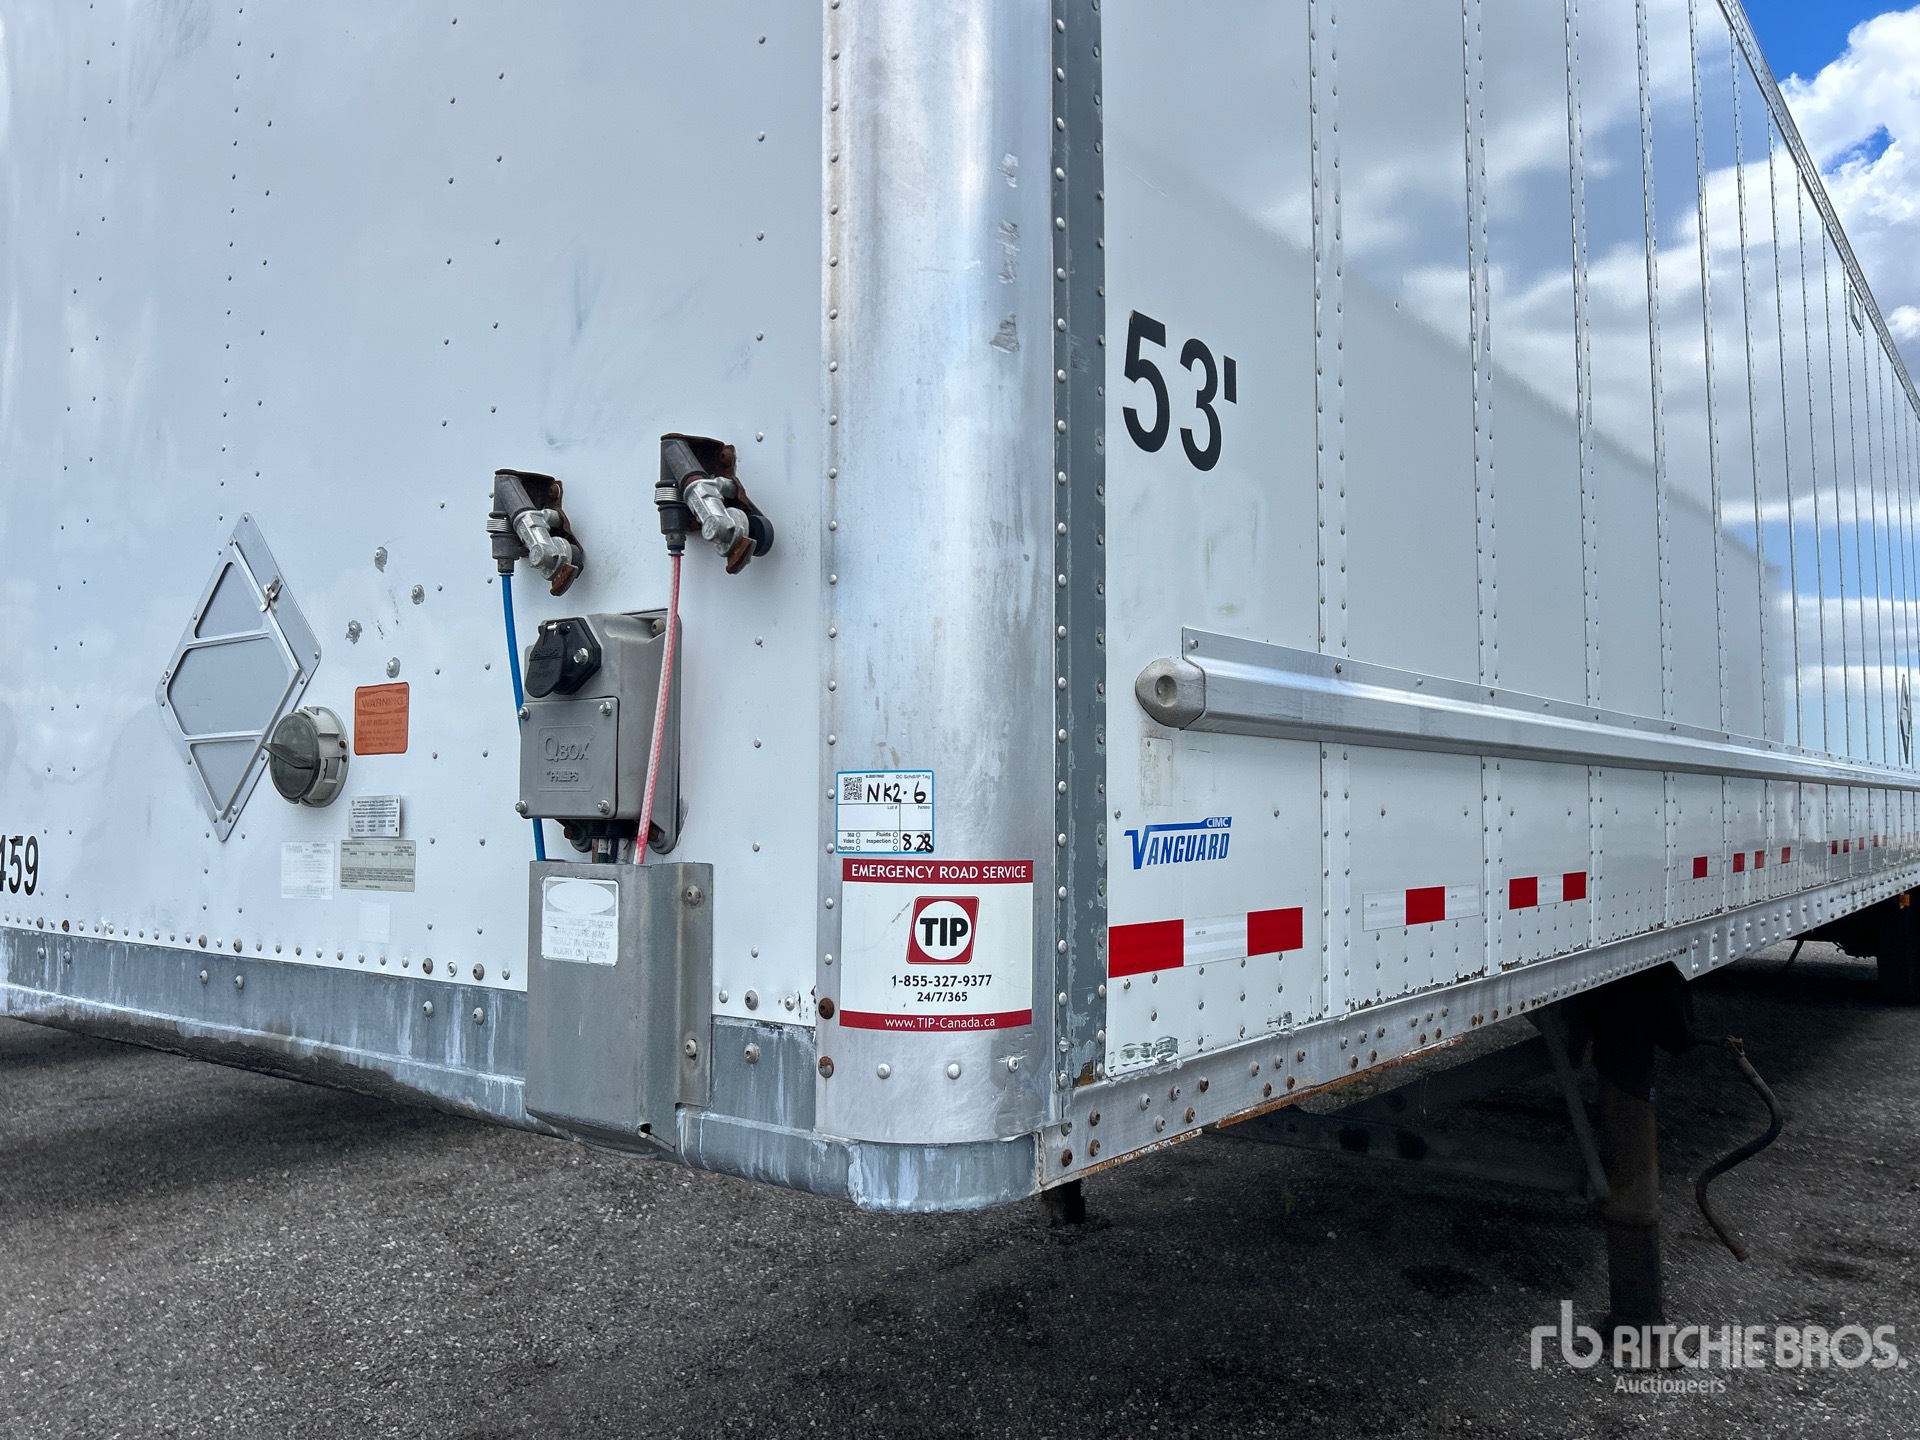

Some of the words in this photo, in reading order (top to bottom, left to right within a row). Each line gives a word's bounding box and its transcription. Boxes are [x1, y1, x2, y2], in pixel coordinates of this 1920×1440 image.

[1122, 309, 1237, 472] 53'
[1206, 817, 1229, 828] CIMC
[1124, 825, 1230, 870] VANGUARD
[851, 863, 935, 879] EMERGENCY
[939, 865, 979, 879] ROAD
[982, 865, 1027, 879] SERVICE
[919, 917, 969, 946] TIP
[891, 974, 992, 987] 1-855-327-9377
[917, 991, 968, 1002] 24/7/365
[885, 1017, 996, 1029] www.TIP-Canada.ca
